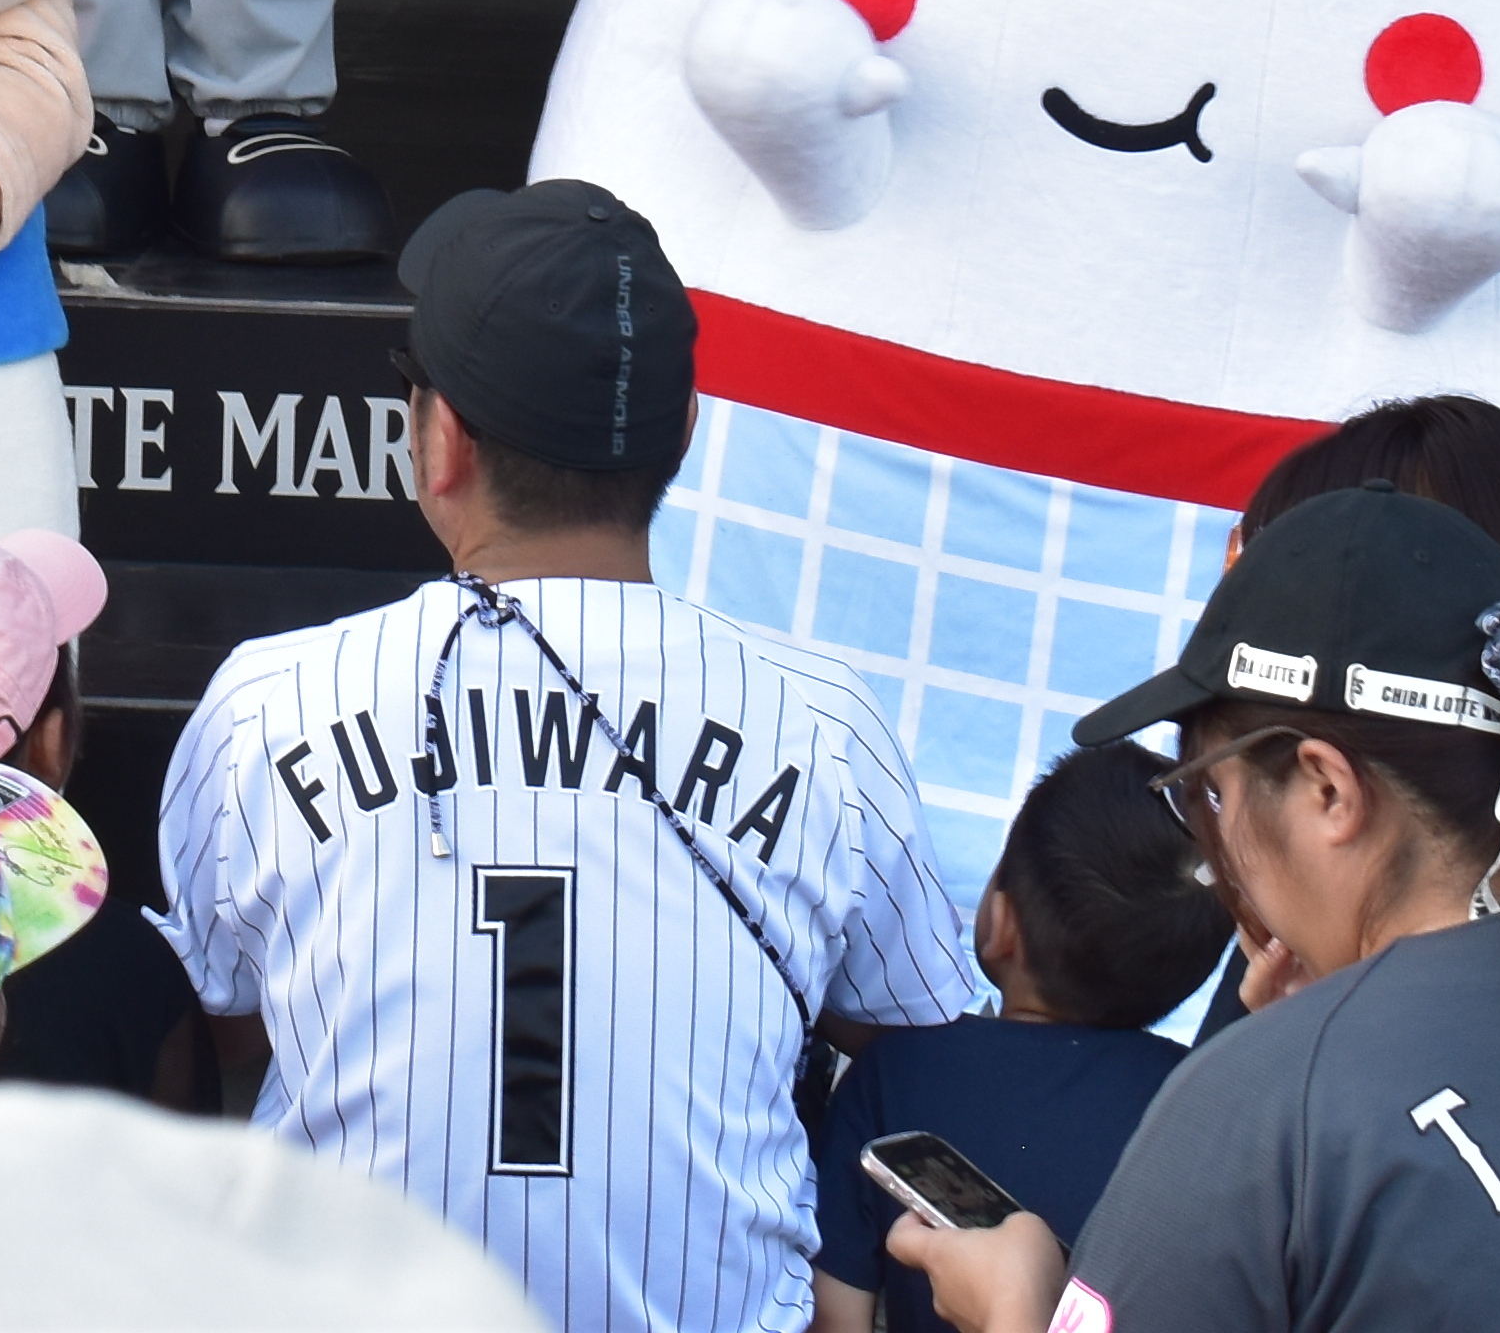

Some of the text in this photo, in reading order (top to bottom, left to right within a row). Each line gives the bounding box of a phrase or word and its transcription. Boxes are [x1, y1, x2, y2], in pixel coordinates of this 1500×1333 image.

[274, 687, 802, 866] FUJIWARA
[1380, 684, 1429, 711] CHIBA
[471, 862, 578, 1179] 1
